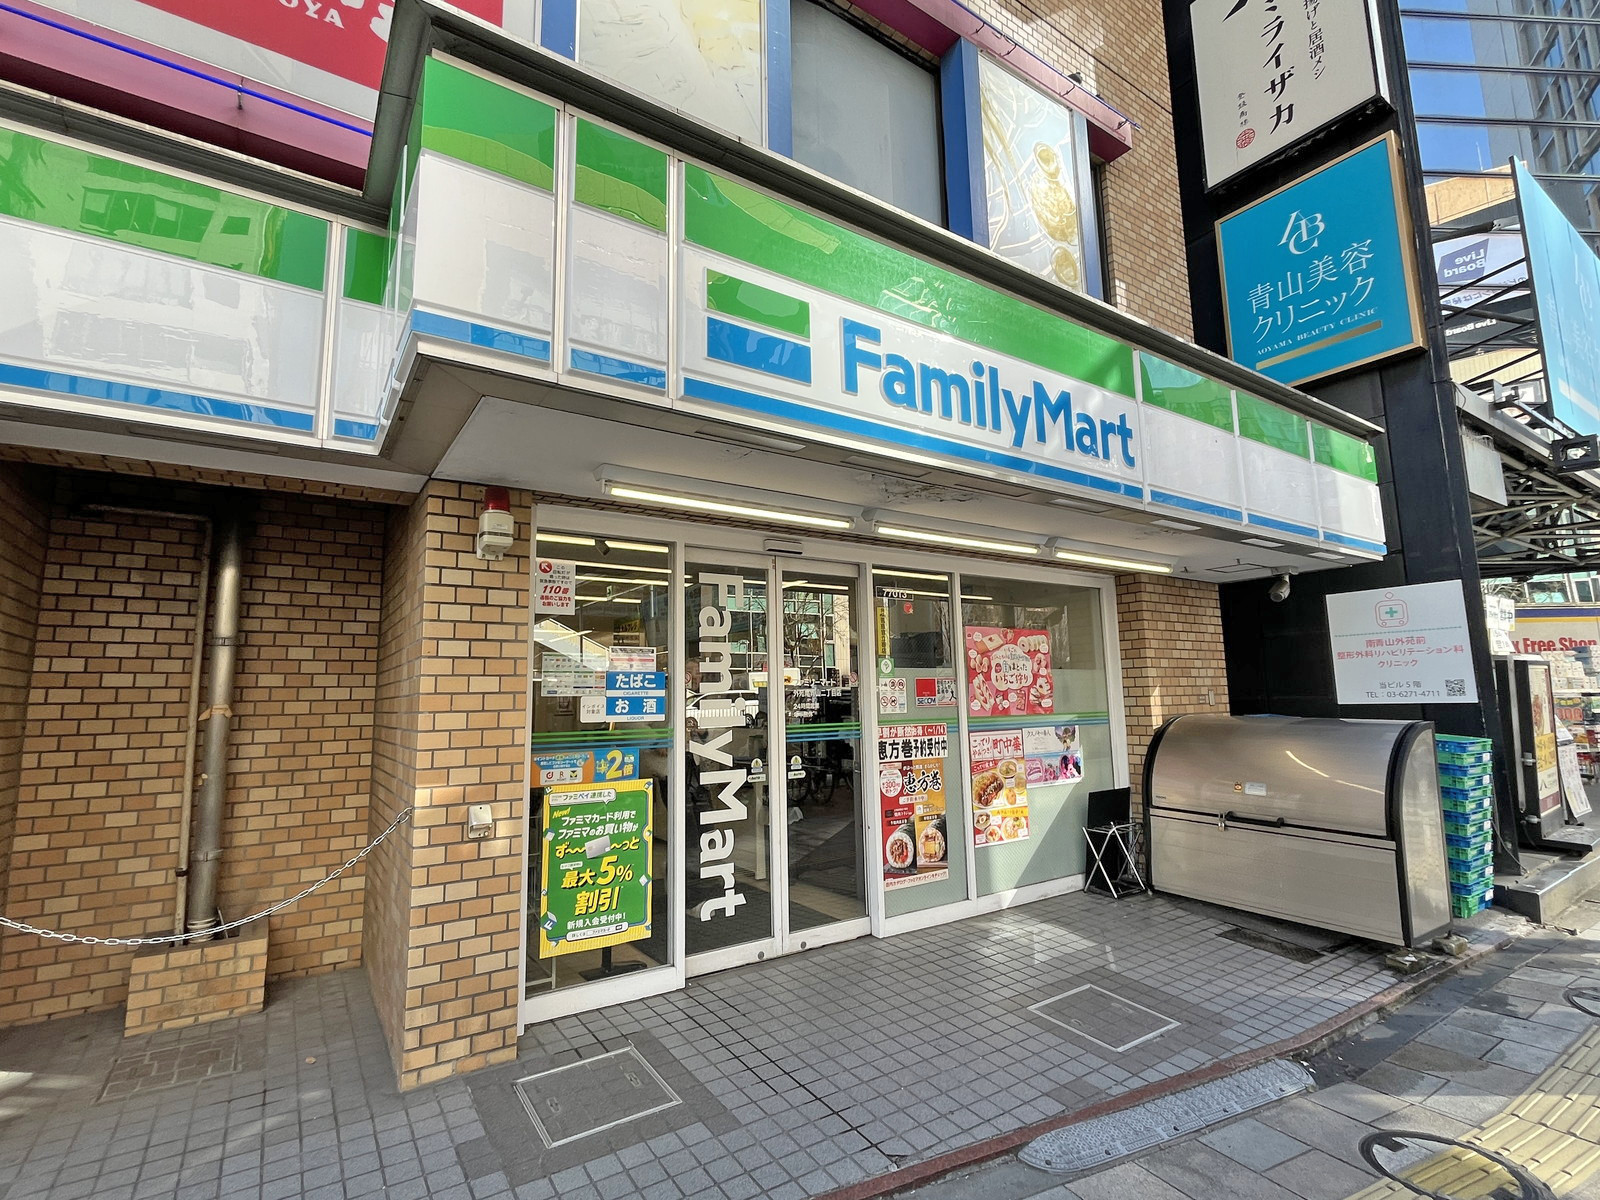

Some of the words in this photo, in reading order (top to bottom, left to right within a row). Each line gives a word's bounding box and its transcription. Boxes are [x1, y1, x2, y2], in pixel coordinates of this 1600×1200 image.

[1247, 239, 1375, 314] 青山美容
[1252, 276, 1375, 343] クリニック
[1256, 339, 1293, 356] AOYAMA
[1297, 321, 1336, 341] BEAUTY
[1339, 306, 1379, 326] CLINIC
[840, 316, 1136, 469] FamilyMart
[542, 584, 570, 595] 110番
[1365, 636, 1426, 648] 南青山外苑前
[1522, 637, 1556, 653] Free
[1337, 644, 1464, 660] 整形外科リハビリテーション科
[1378, 659, 1419, 668] クリニック
[615, 673, 657, 689] たばこ
[615, 698, 657, 714] お酒
[689, 571, 748, 922] FamilyMart
[878, 736, 947, 760] 恵方巻予約受付中
[972, 737, 990, 748] こってり
[992, 735, 1021, 755] 町中華
[605, 749, 634, 780] 2倍
[903, 770, 942, 794] 恵方巻
[562, 791, 613, 801] ファミペイ連携した
[561, 810, 636, 826] ファミマカード利用で
[557, 823, 639, 840] ファミマのお買い物が
[575, 886, 620, 916] 割引
[566, 912, 627, 930] 新規入会受付中!
